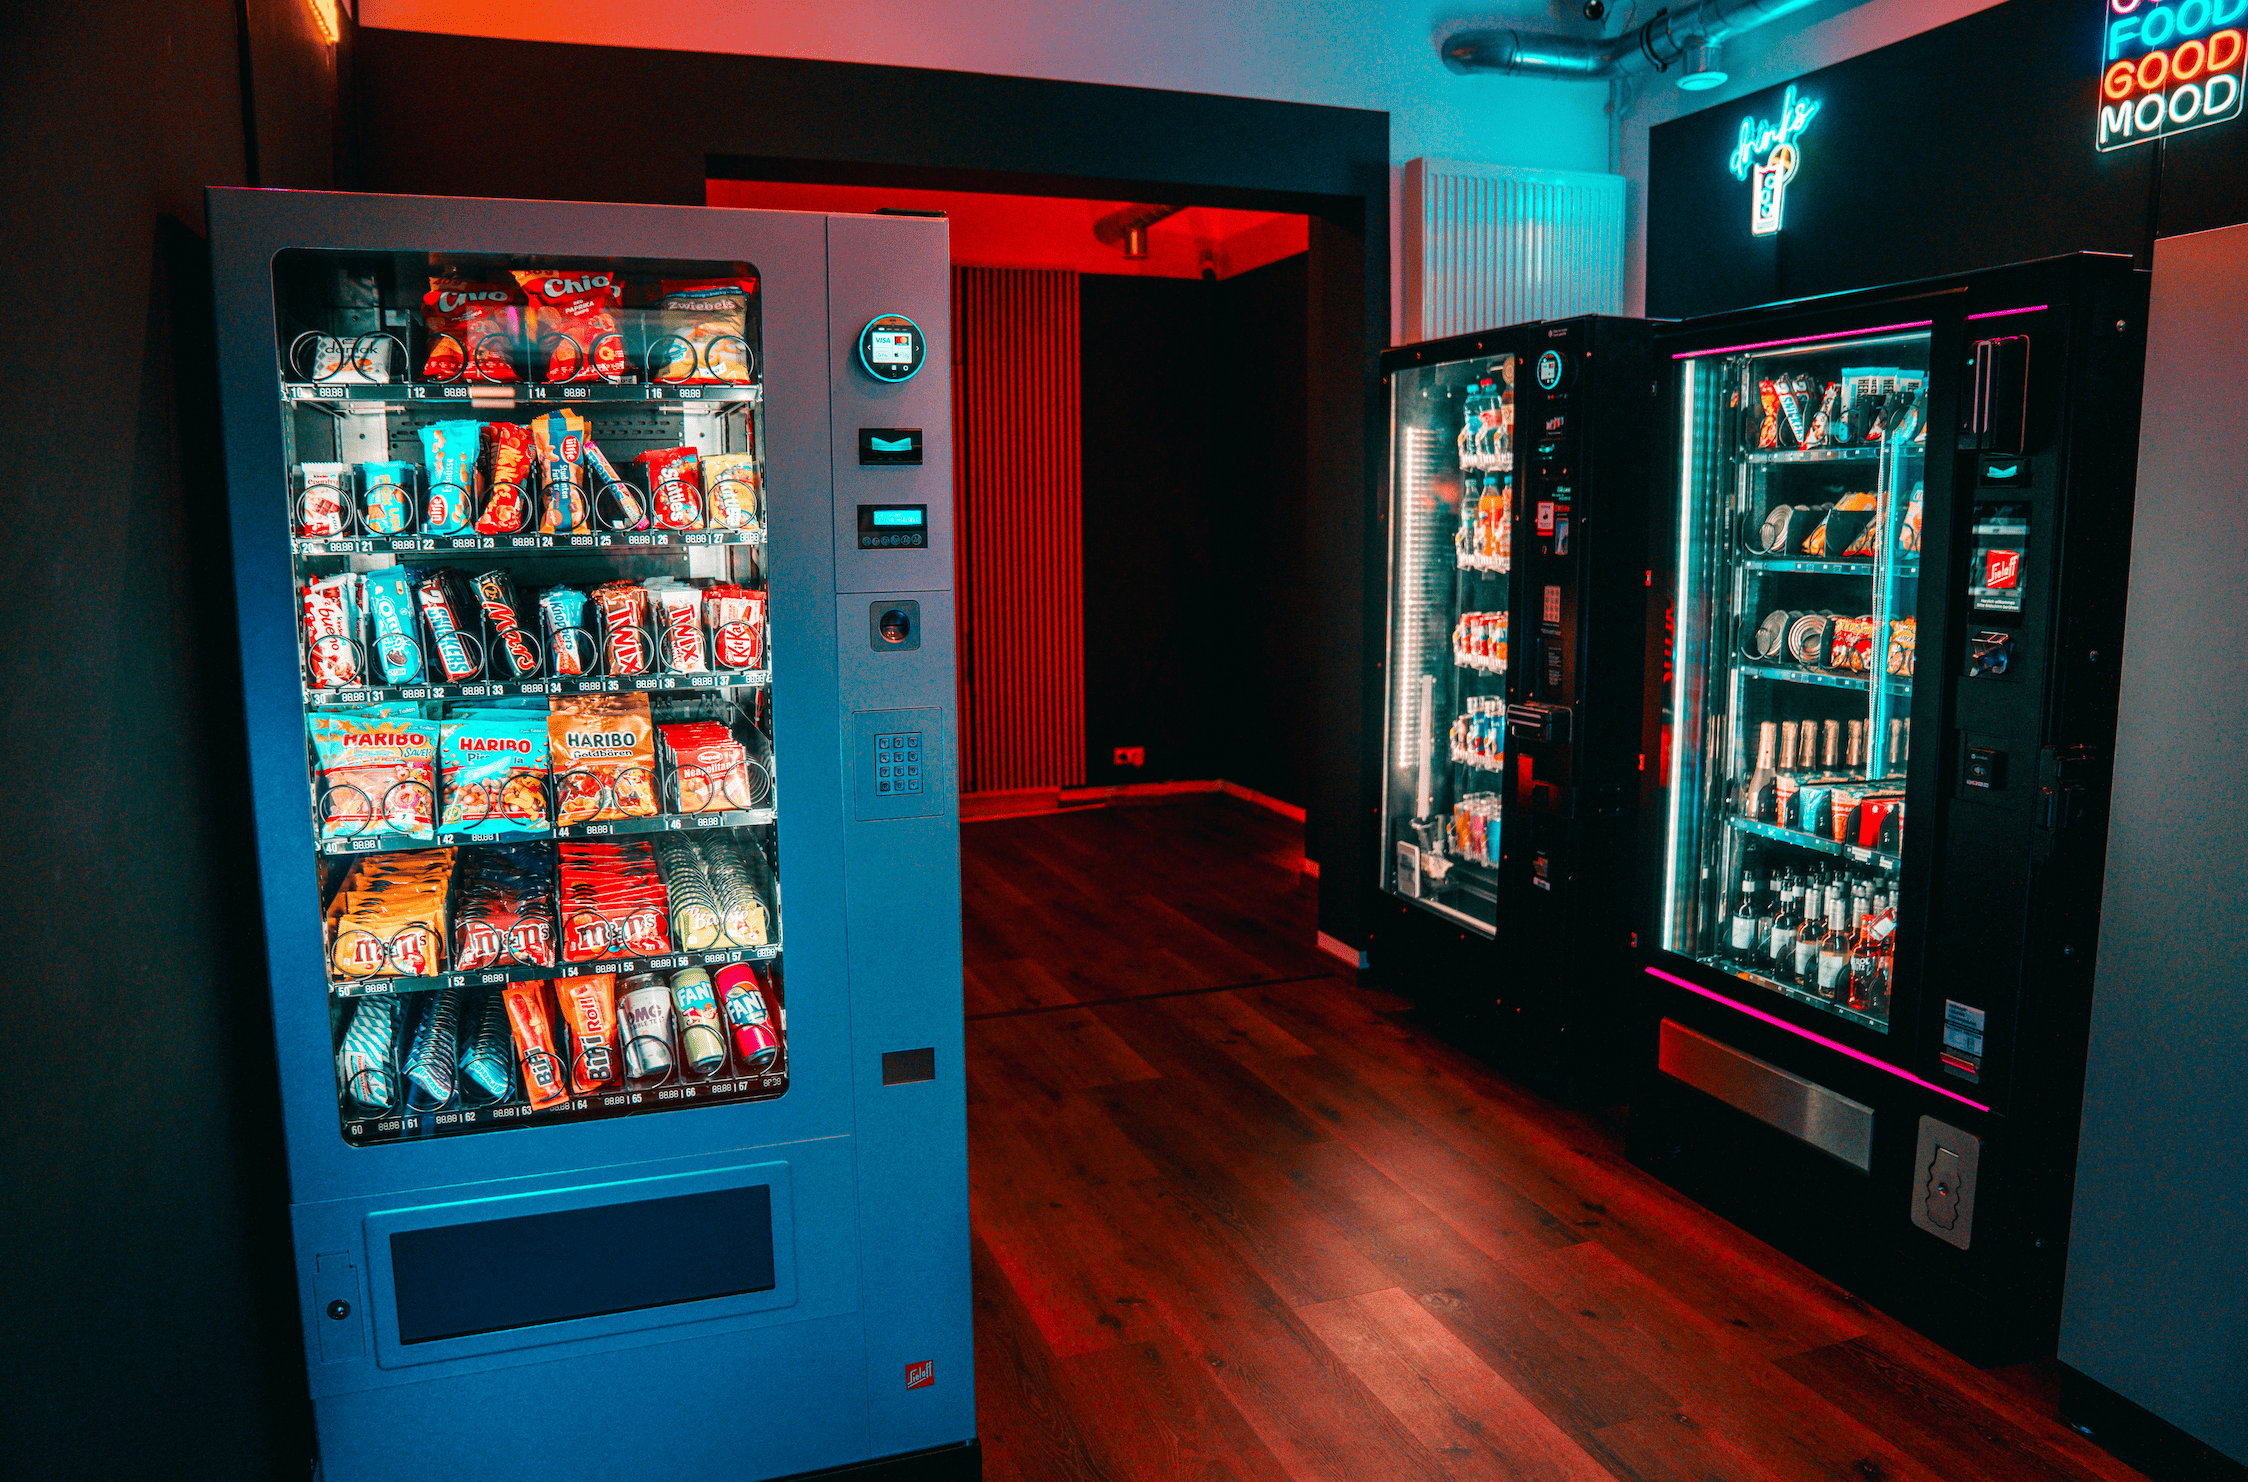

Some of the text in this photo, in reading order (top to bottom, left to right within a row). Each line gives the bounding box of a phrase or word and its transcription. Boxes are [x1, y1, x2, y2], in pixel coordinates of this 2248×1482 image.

[2109, 0, 2248, 60] FOOD
[2104, 29, 2243, 99] GOOD
[2100, 74, 2238, 144] MOOD
[544, 275, 610, 298] Chio
[565, 301, 594, 314] PAPRIKA
[668, 299, 736, 311] Zwiebels
[413, 388, 425, 398] 12
[535, 388, 546, 398] 14
[652, 388, 662, 398] 16
[565, 438, 577, 460] ültje
[552, 469, 560, 491] Futer
[560, 465, 570, 499] Studnten
[380, 475, 392, 505] PCK
[430, 497, 444, 522] ültje
[484, 538, 494, 548] 23
[542, 537, 553, 546] 24
[601, 536, 611, 545] 25
[657, 535, 668, 545] 26
[713, 534, 724, 543] 27
[362, 541, 373, 551] 21
[423, 540, 434, 550] 22
[318, 608, 340, 651] bueno
[550, 602, 573, 650] Knoppers
[482, 602, 536, 670] Mars
[607, 601, 645, 674] TWIX
[671, 604, 699, 663] TWIX
[427, 608, 471, 673] SNICKERS
[608, 681, 619, 690] 35
[664, 678, 675, 688] 36
[720, 676, 730, 685] 37
[433, 688, 444, 698] 32
[493, 685, 503, 695] 33
[551, 683, 561, 693] 34
[314, 694, 325, 704] 30
[373, 691, 384, 701] 31
[343, 733, 425, 747] HARIBO
[566, 732, 636, 748] HARIBO
[460, 737, 531, 754] HARIBO
[574, 750, 633, 758] Goldbären
[671, 819, 681, 829] 46
[559, 827, 569, 837] 44
[443, 834, 454, 844] 42
[678, 957, 688, 966] 56
[732, 952, 742, 962] 57
[624, 962, 634, 971] 55
[568, 967, 578, 977] 54
[454, 977, 465, 986] 52
[339, 986, 349, 996] 50
[677, 982, 715, 1007] FANT
[726, 991, 767, 1024] FANT
[579, 997, 603, 1033] Roll
[738, 1082, 748, 1092] 67
[686, 1088, 696, 1097] 66
[632, 1094, 642, 1104] 65
[522, 1105, 532, 1115] 63
[577, 1100, 587, 1110] 64
[466, 1112, 476, 1122] 62
[408, 1119, 418, 1129] 61
[352, 1125, 363, 1135] 60
